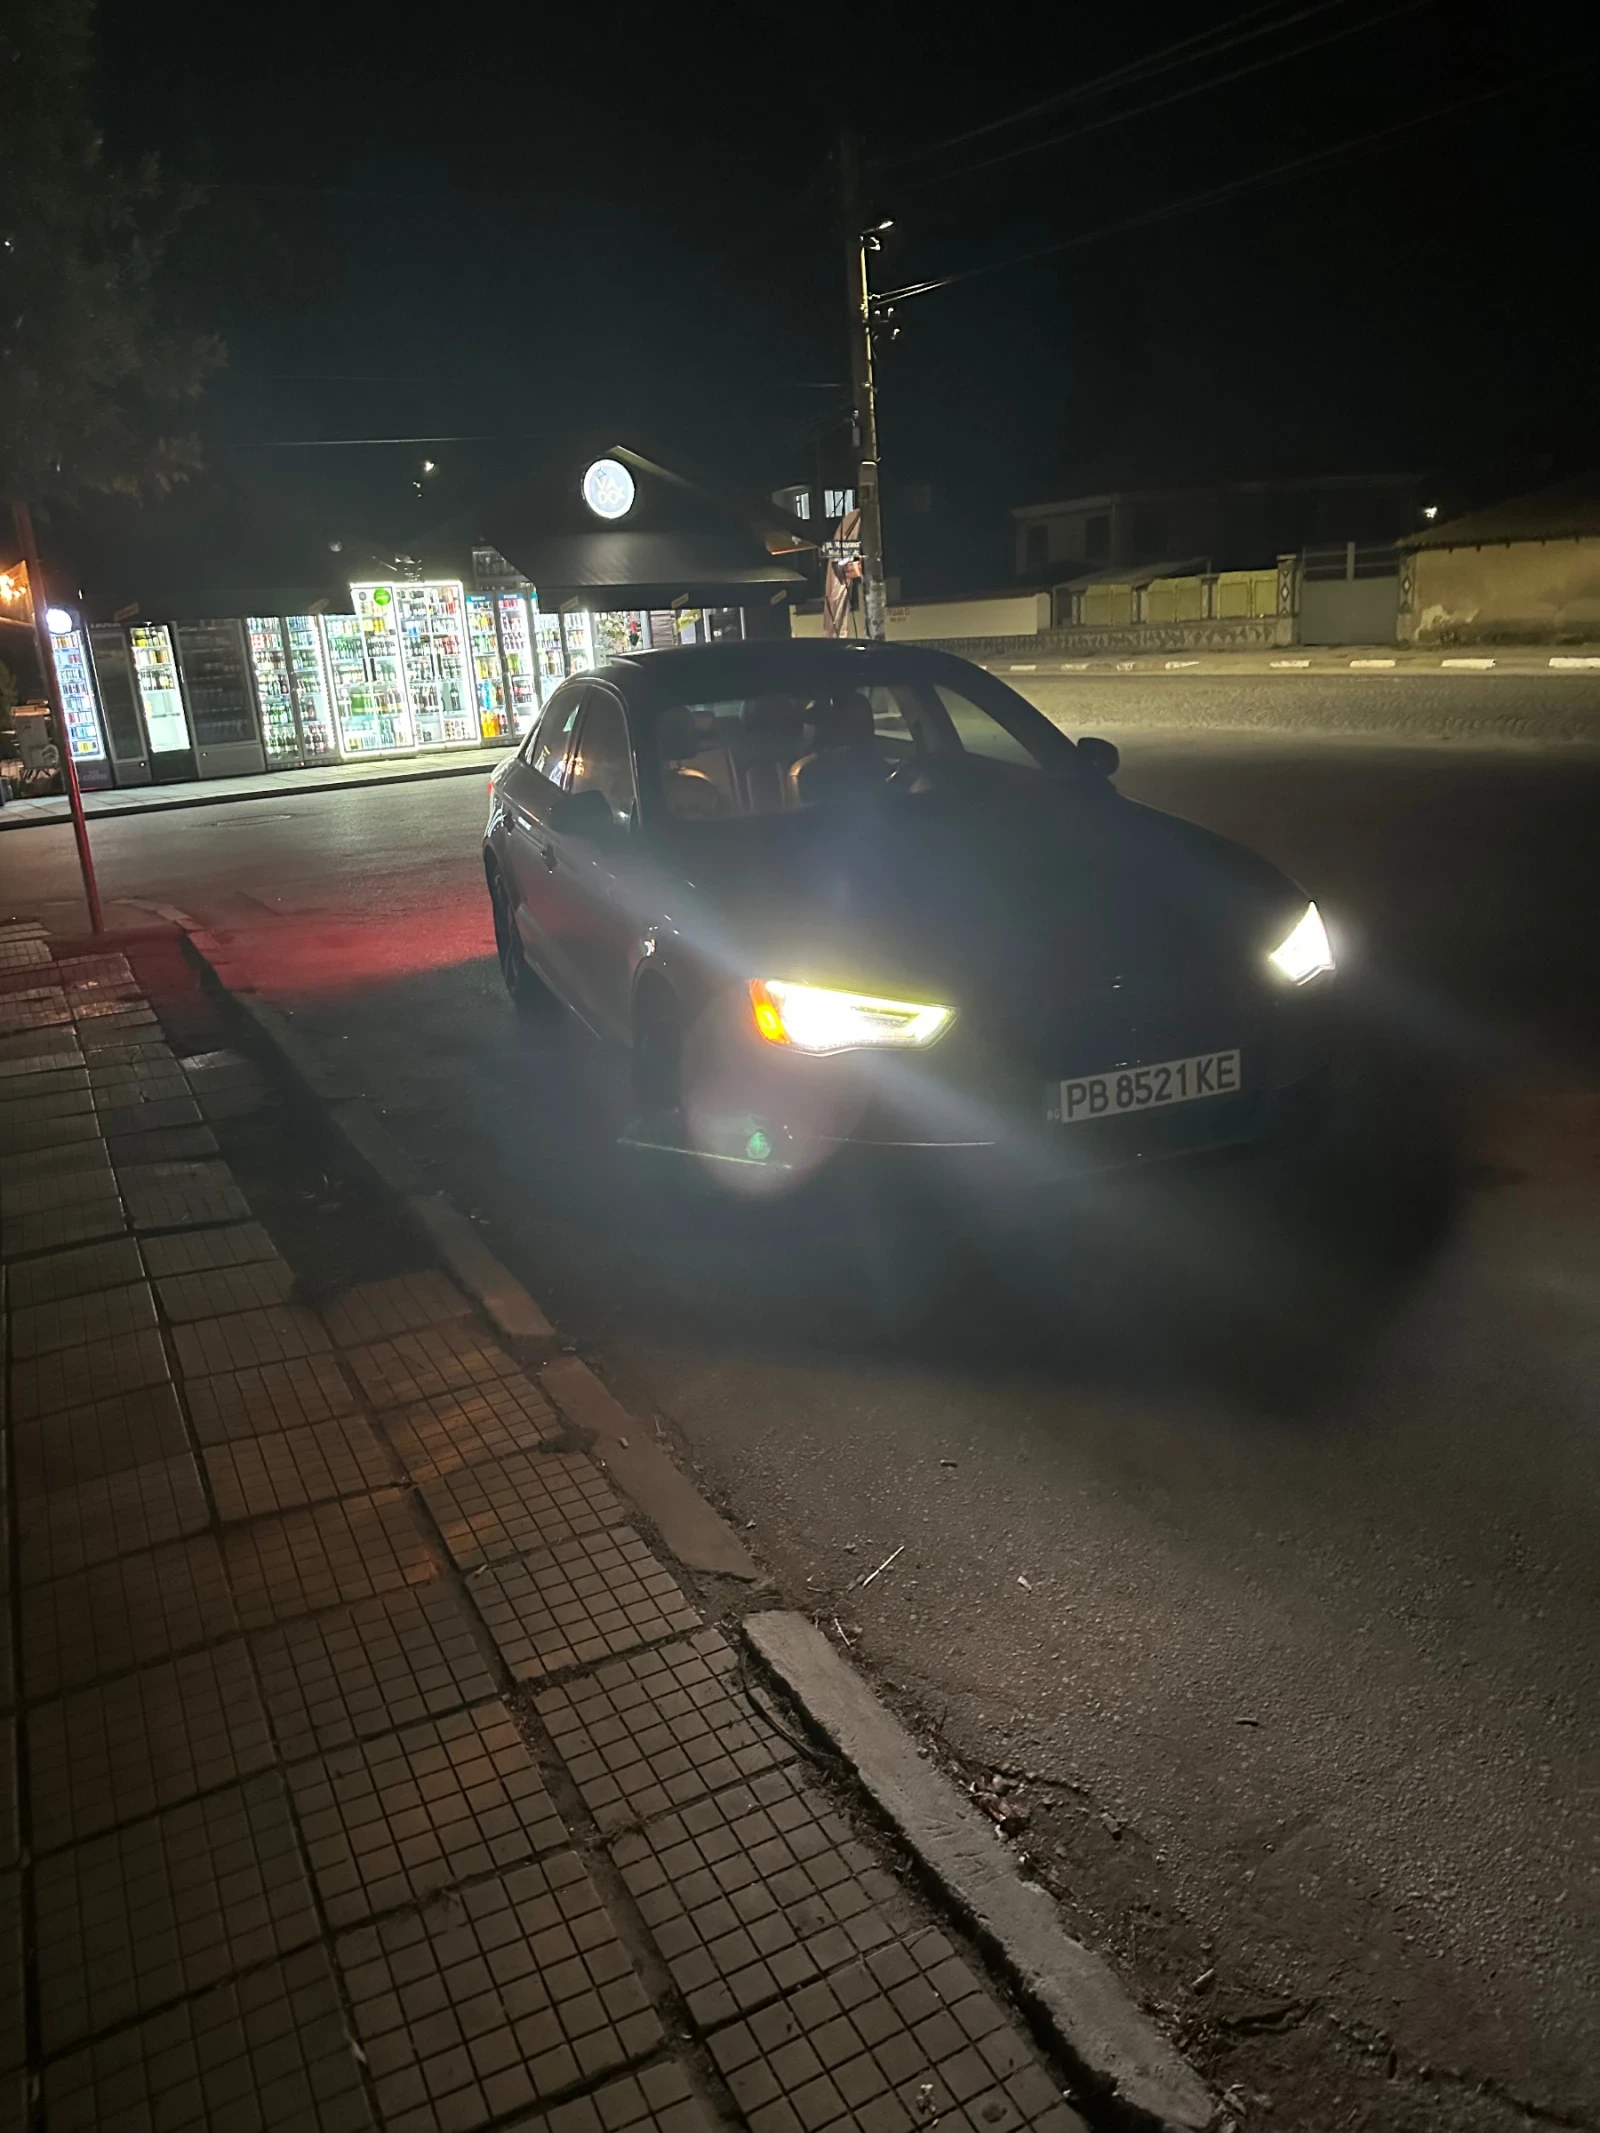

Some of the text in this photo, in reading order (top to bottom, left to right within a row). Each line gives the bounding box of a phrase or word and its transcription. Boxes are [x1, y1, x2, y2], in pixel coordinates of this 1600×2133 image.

[1066, 1054, 1236, 1118] PB 8521 KE
